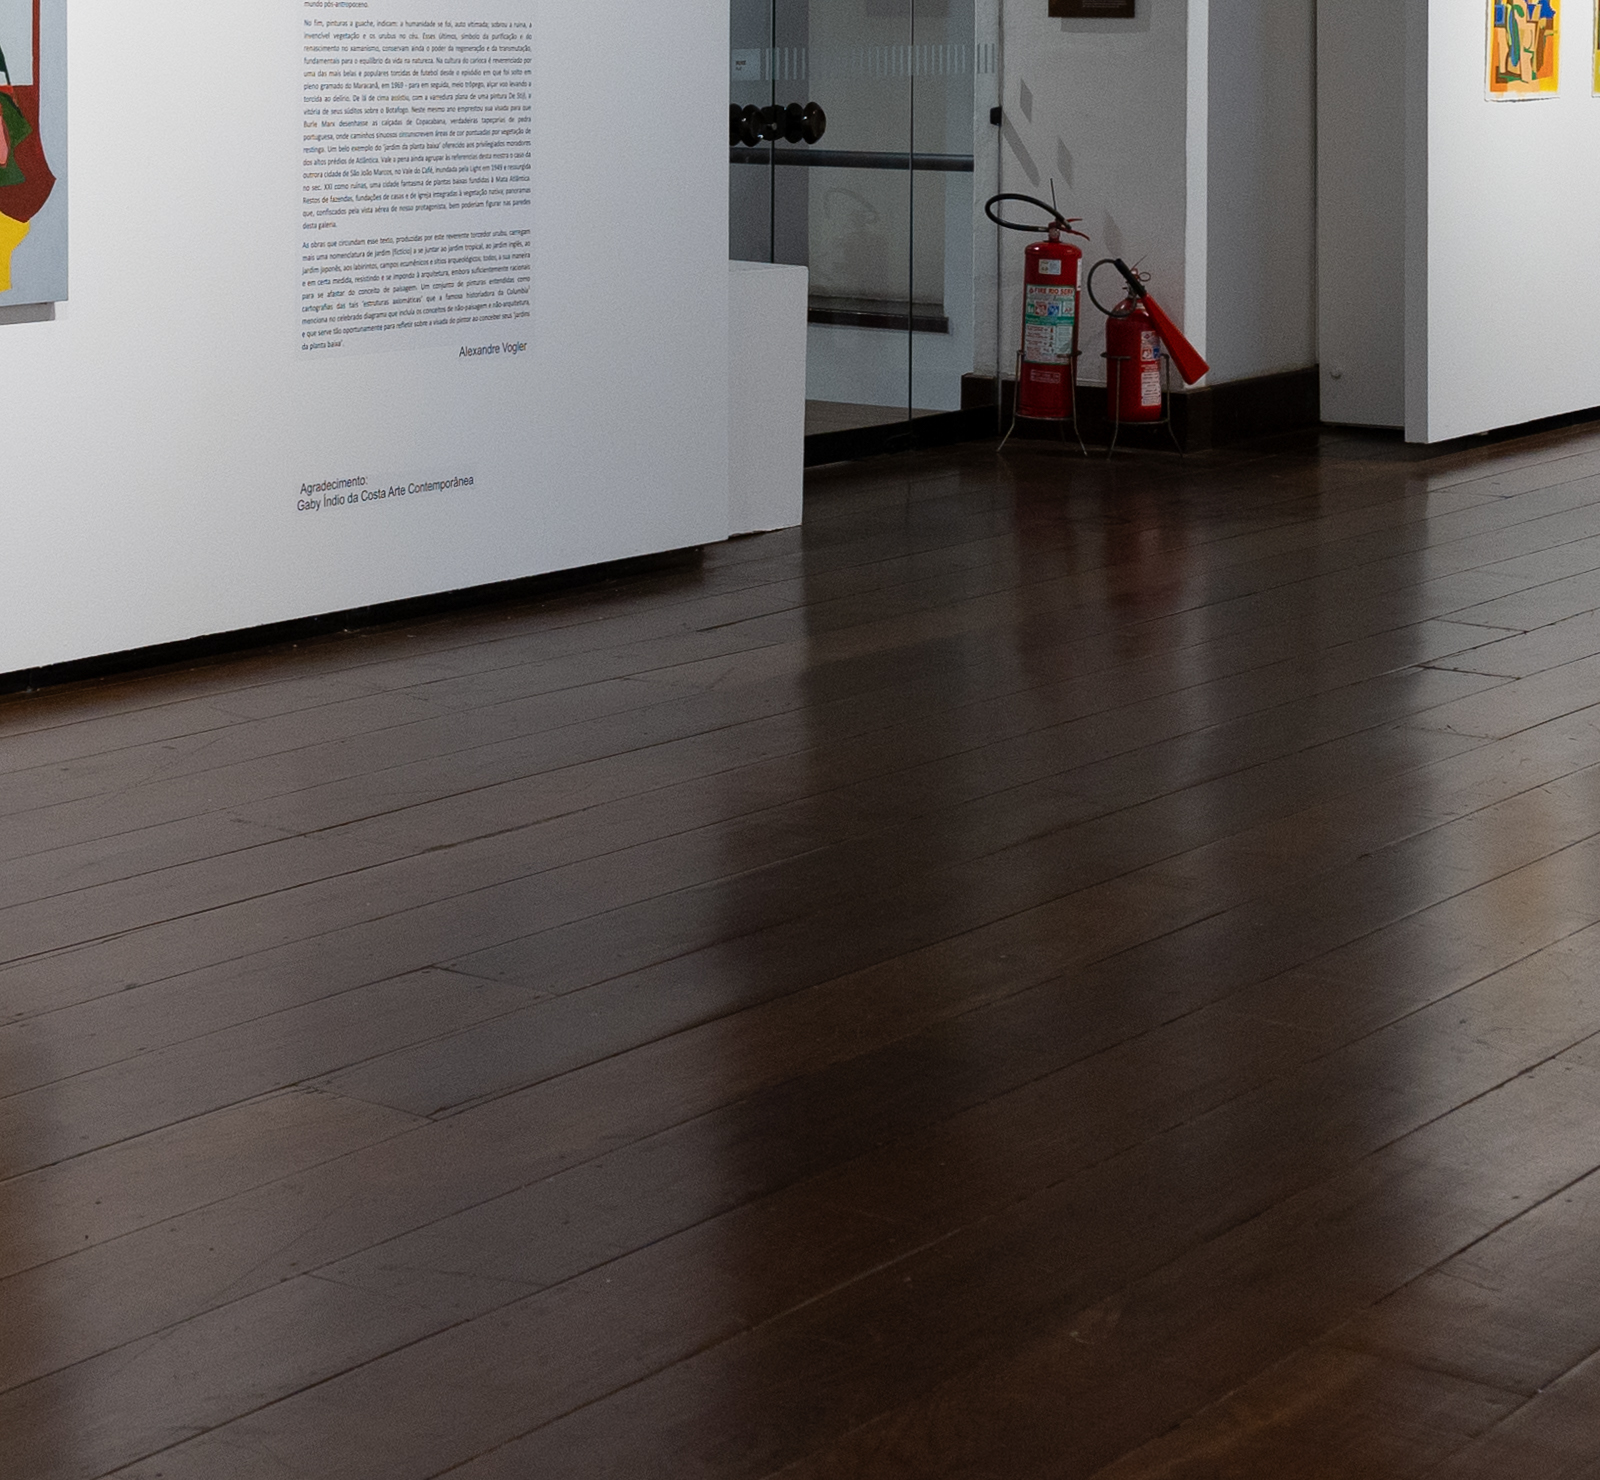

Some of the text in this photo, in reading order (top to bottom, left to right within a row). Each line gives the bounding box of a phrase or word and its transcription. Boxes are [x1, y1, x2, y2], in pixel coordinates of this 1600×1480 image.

[459, 340, 527, 357] Alexandre Vogler
[297, 475, 474, 512] Gaby Índio da Costa Arte Contemporânea
[300, 476, 368, 496] Agradecimento:
